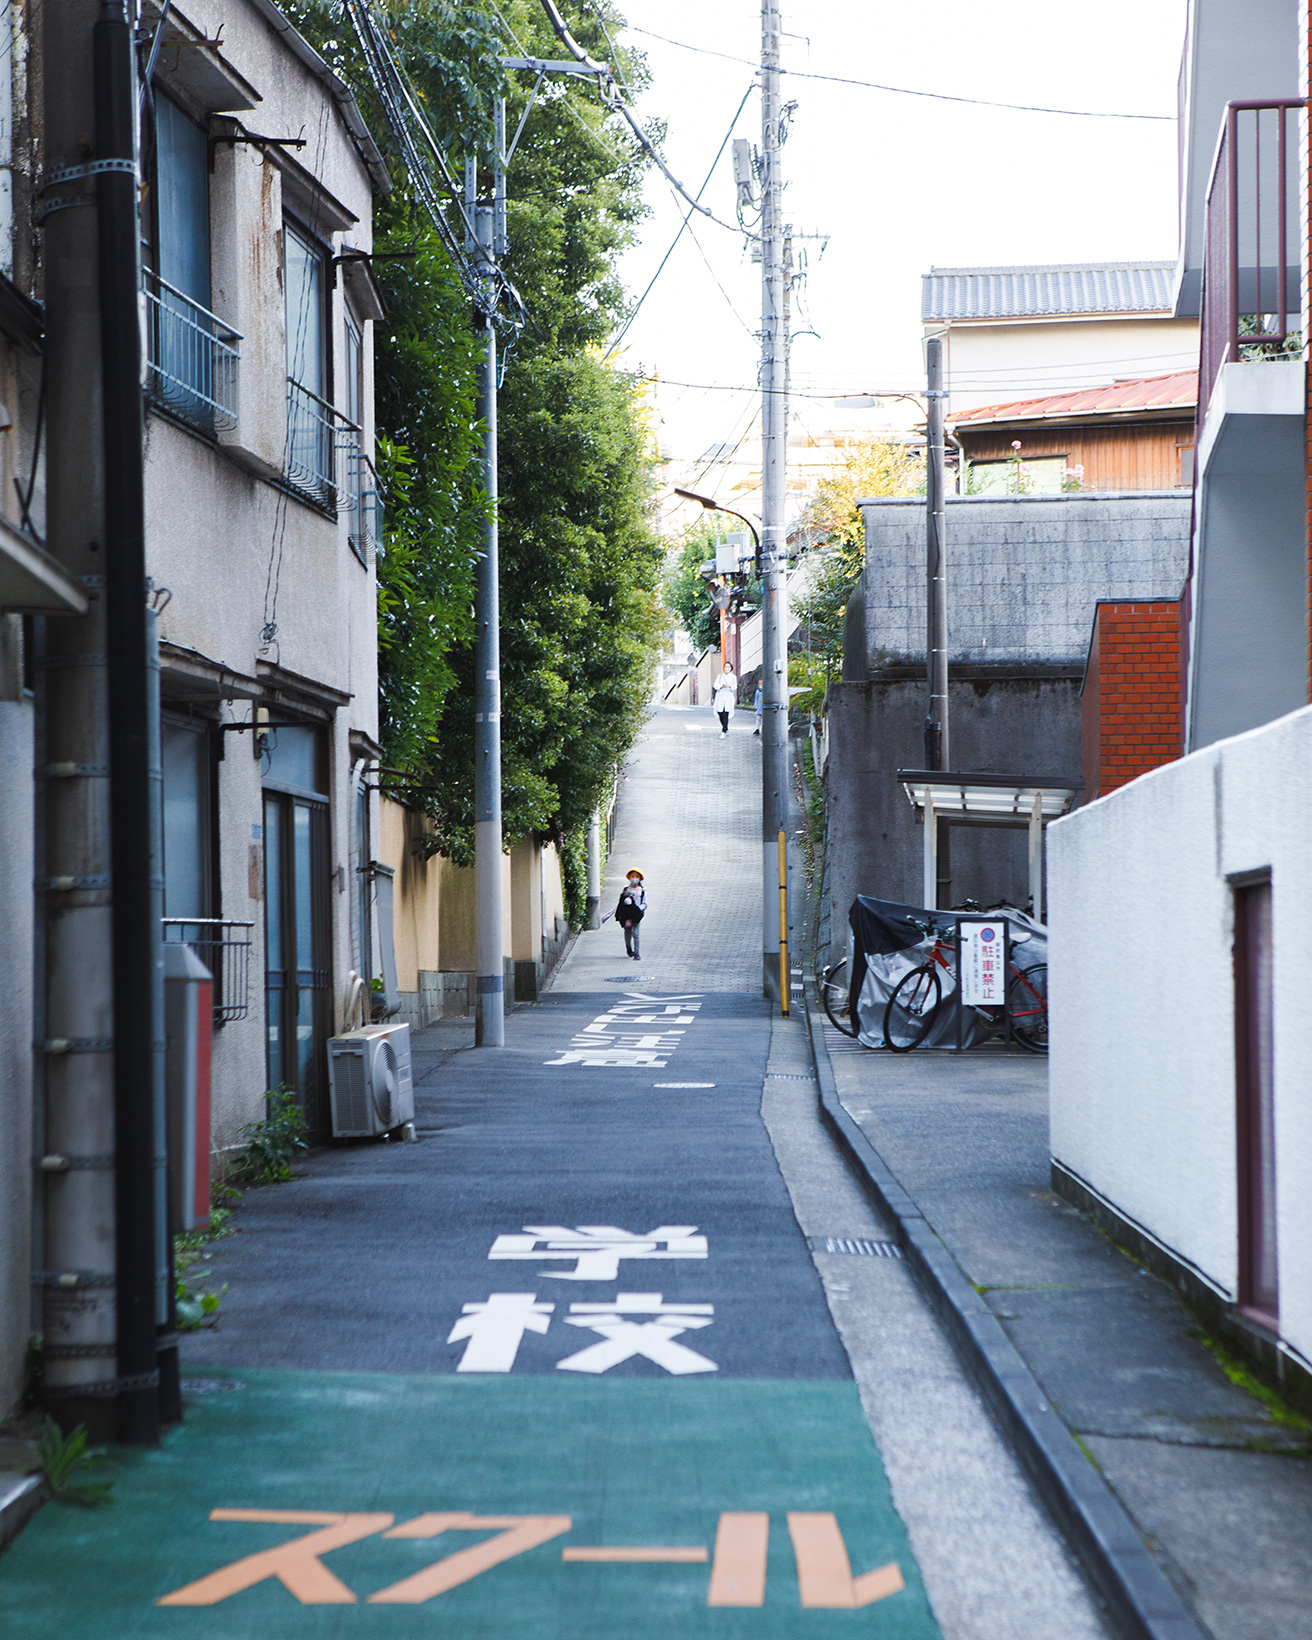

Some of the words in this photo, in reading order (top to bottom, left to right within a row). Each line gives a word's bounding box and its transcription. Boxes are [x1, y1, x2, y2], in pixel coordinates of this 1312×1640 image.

[982, 945, 995, 999] 駐車禁止
[446, 1224, 718, 1375] 学校
[157, 1510, 904, 1607] スクール
